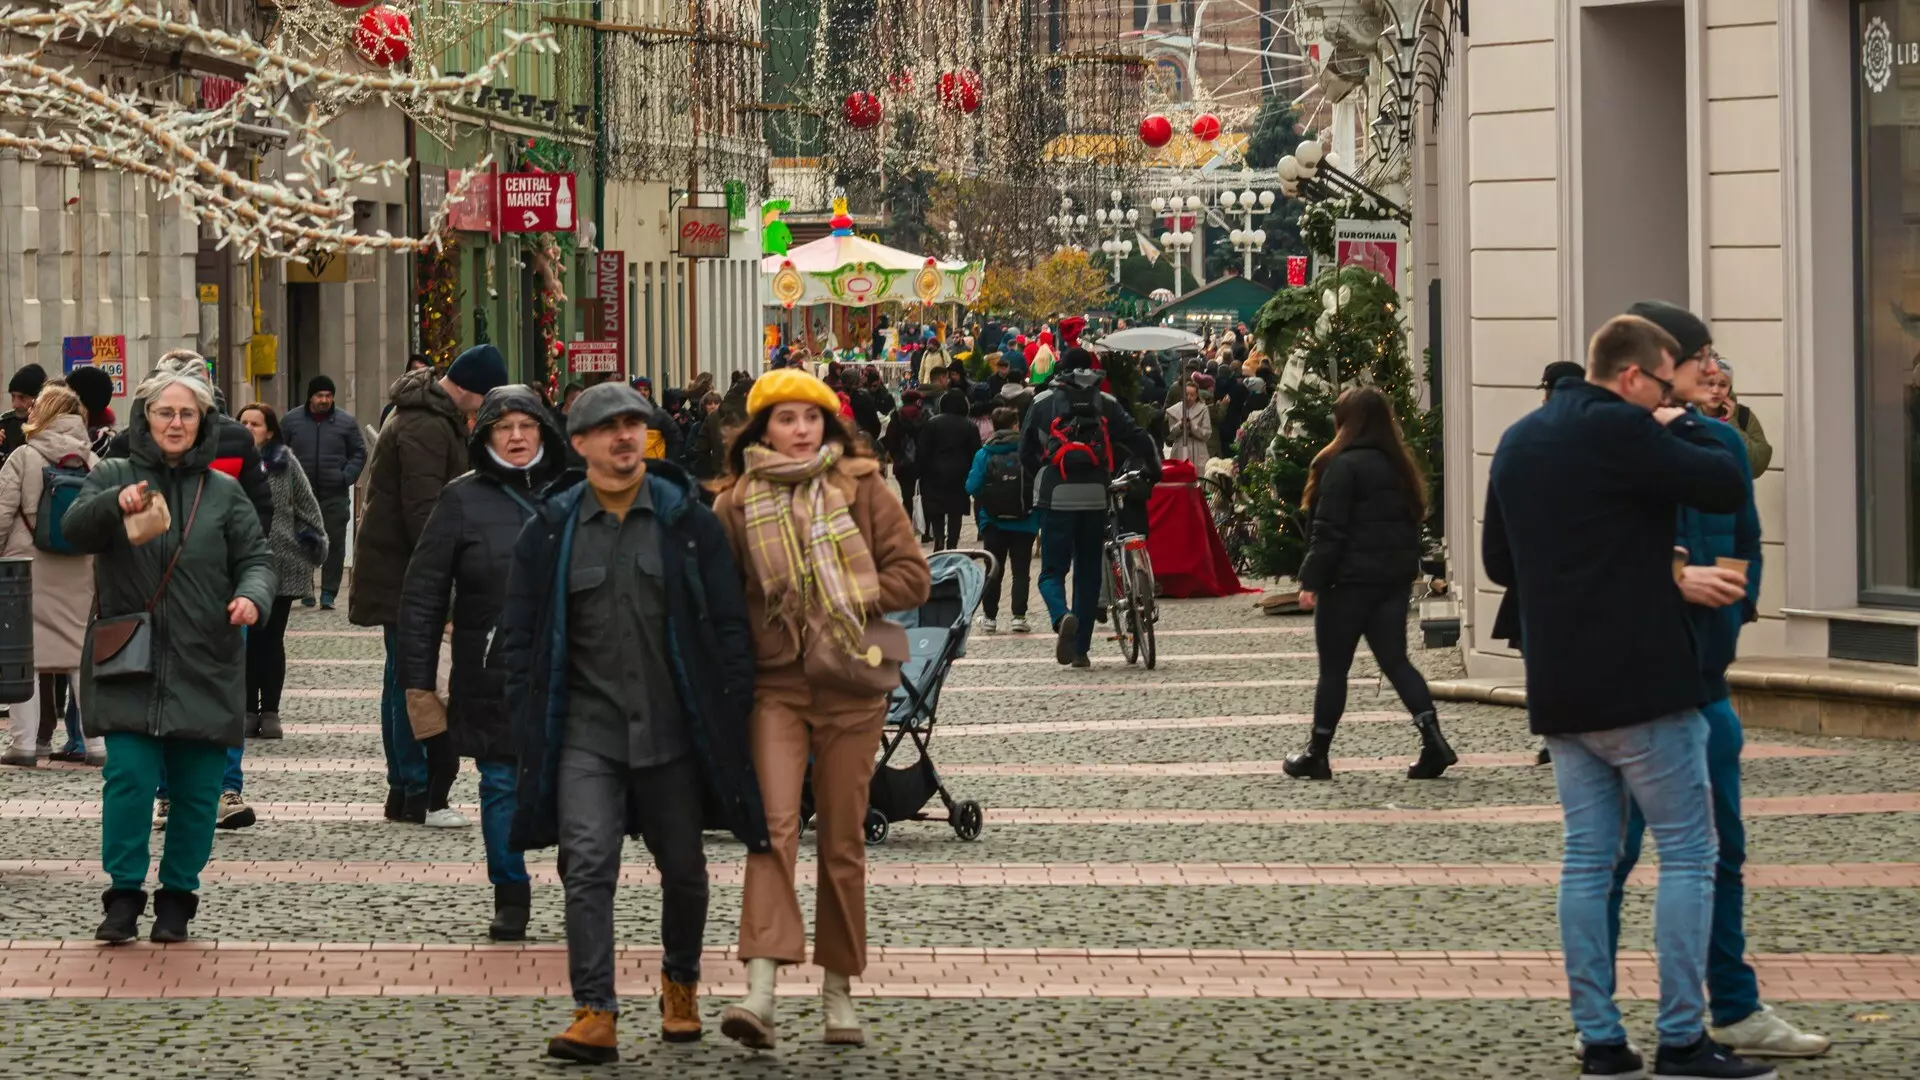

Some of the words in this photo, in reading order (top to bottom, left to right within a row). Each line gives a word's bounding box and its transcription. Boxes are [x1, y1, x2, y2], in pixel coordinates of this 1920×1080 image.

[1897, 43, 1919, 65] LIB
[505, 176, 552, 192] CENTRAL
[507, 192, 551, 207] MARKET
[682, 221, 726, 244] Optic
[1338, 231, 1397, 240] EUROTHALIA
[600, 252, 619, 332] EXCHANGE
